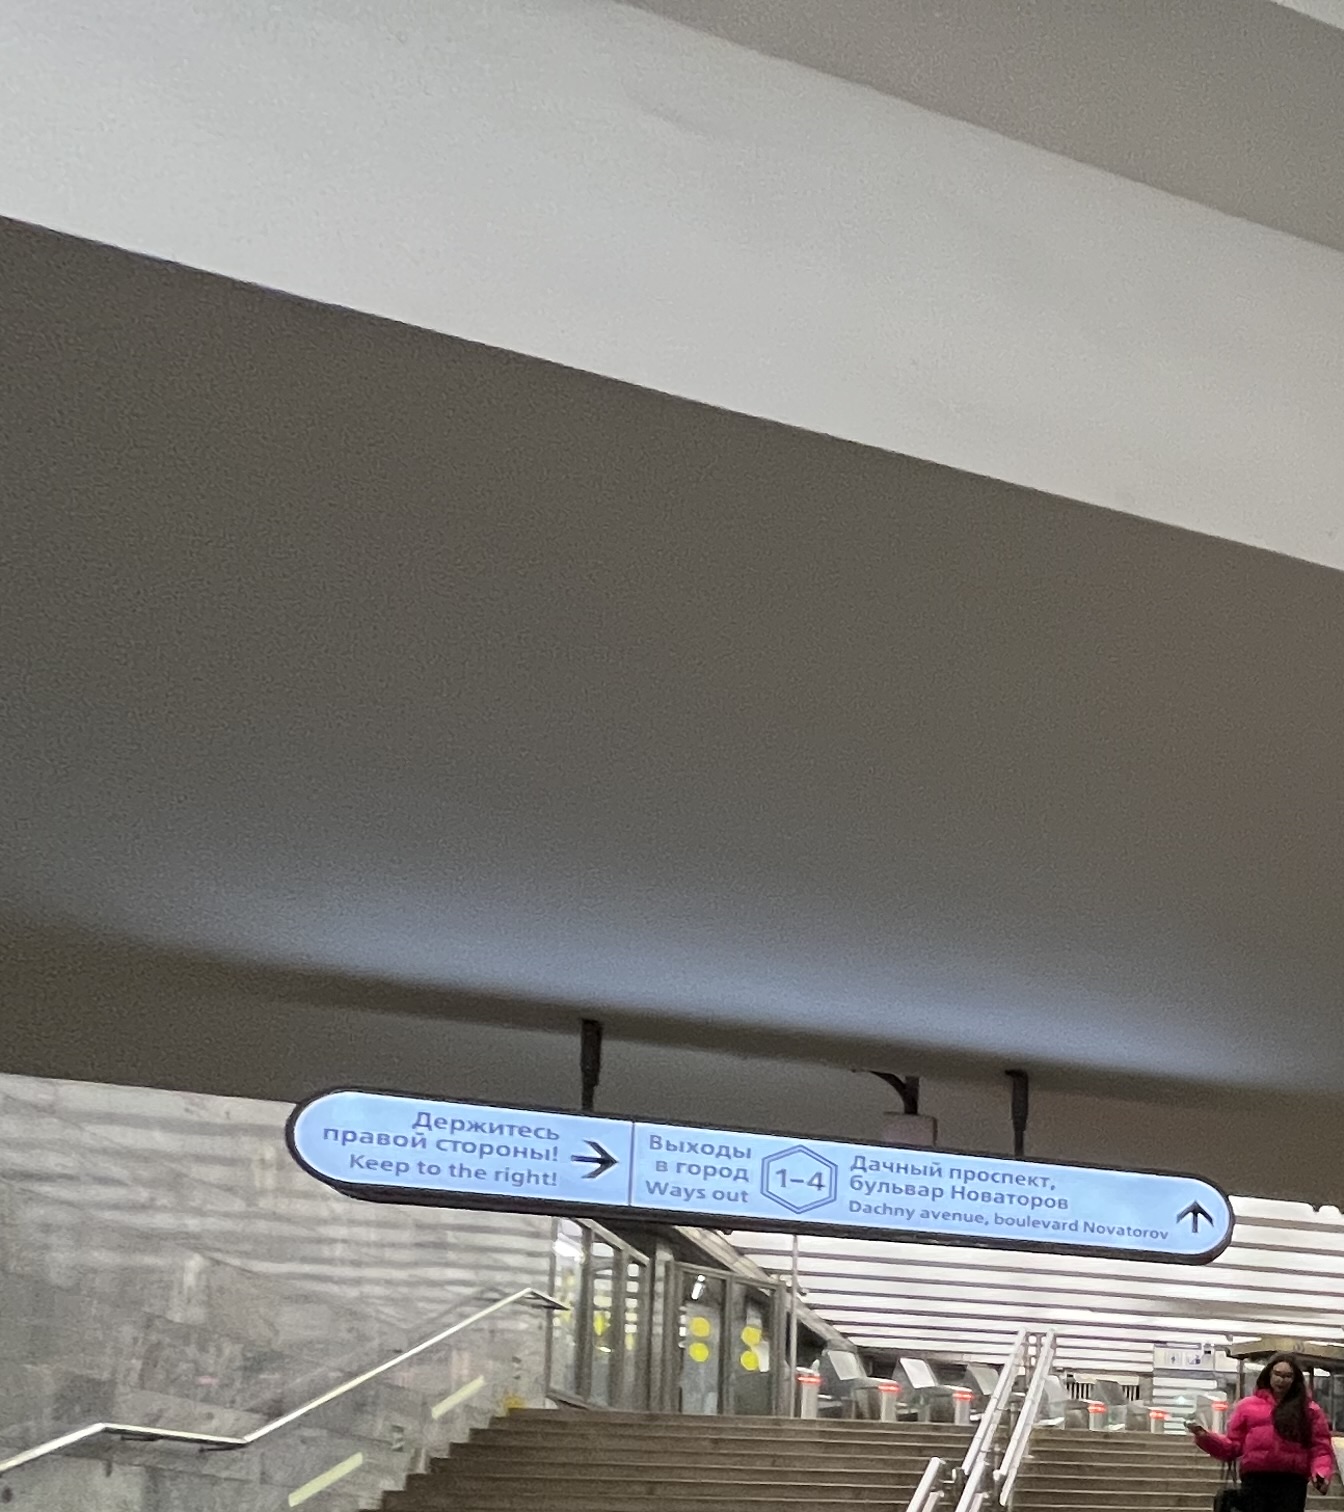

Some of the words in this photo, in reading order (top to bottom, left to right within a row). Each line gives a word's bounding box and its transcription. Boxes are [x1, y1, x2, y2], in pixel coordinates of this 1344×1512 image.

[412, 1111, 560, 1140] Держитесь
[322, 1127, 428, 1150] правой
[435, 1138, 558, 1162] стороны!
[649, 1135, 752, 1160] Выходы
[349, 1154, 410, 1177] Keep
[416, 1161, 442, 1176] to
[449, 1163, 488, 1181] the
[494, 1168, 558, 1187] right!
[655, 1161, 668, 1173] в
[676, 1163, 750, 1183] город
[850, 1154, 943, 1178] Дачный
[949, 1169, 1056, 1191] проспект,
[645, 1180, 706, 1201] Ways
[712, 1187, 750, 1203] out
[850, 1175, 945, 1201] бульвар
[950, 1185, 1069, 1211] Новаторов
[849, 1200, 916, 1221] Dachny
[919, 1210, 990, 1226] avenue,
[994, 1212, 1079, 1233] boulevard
[1083, 1221, 1170, 1241] Novatorov
